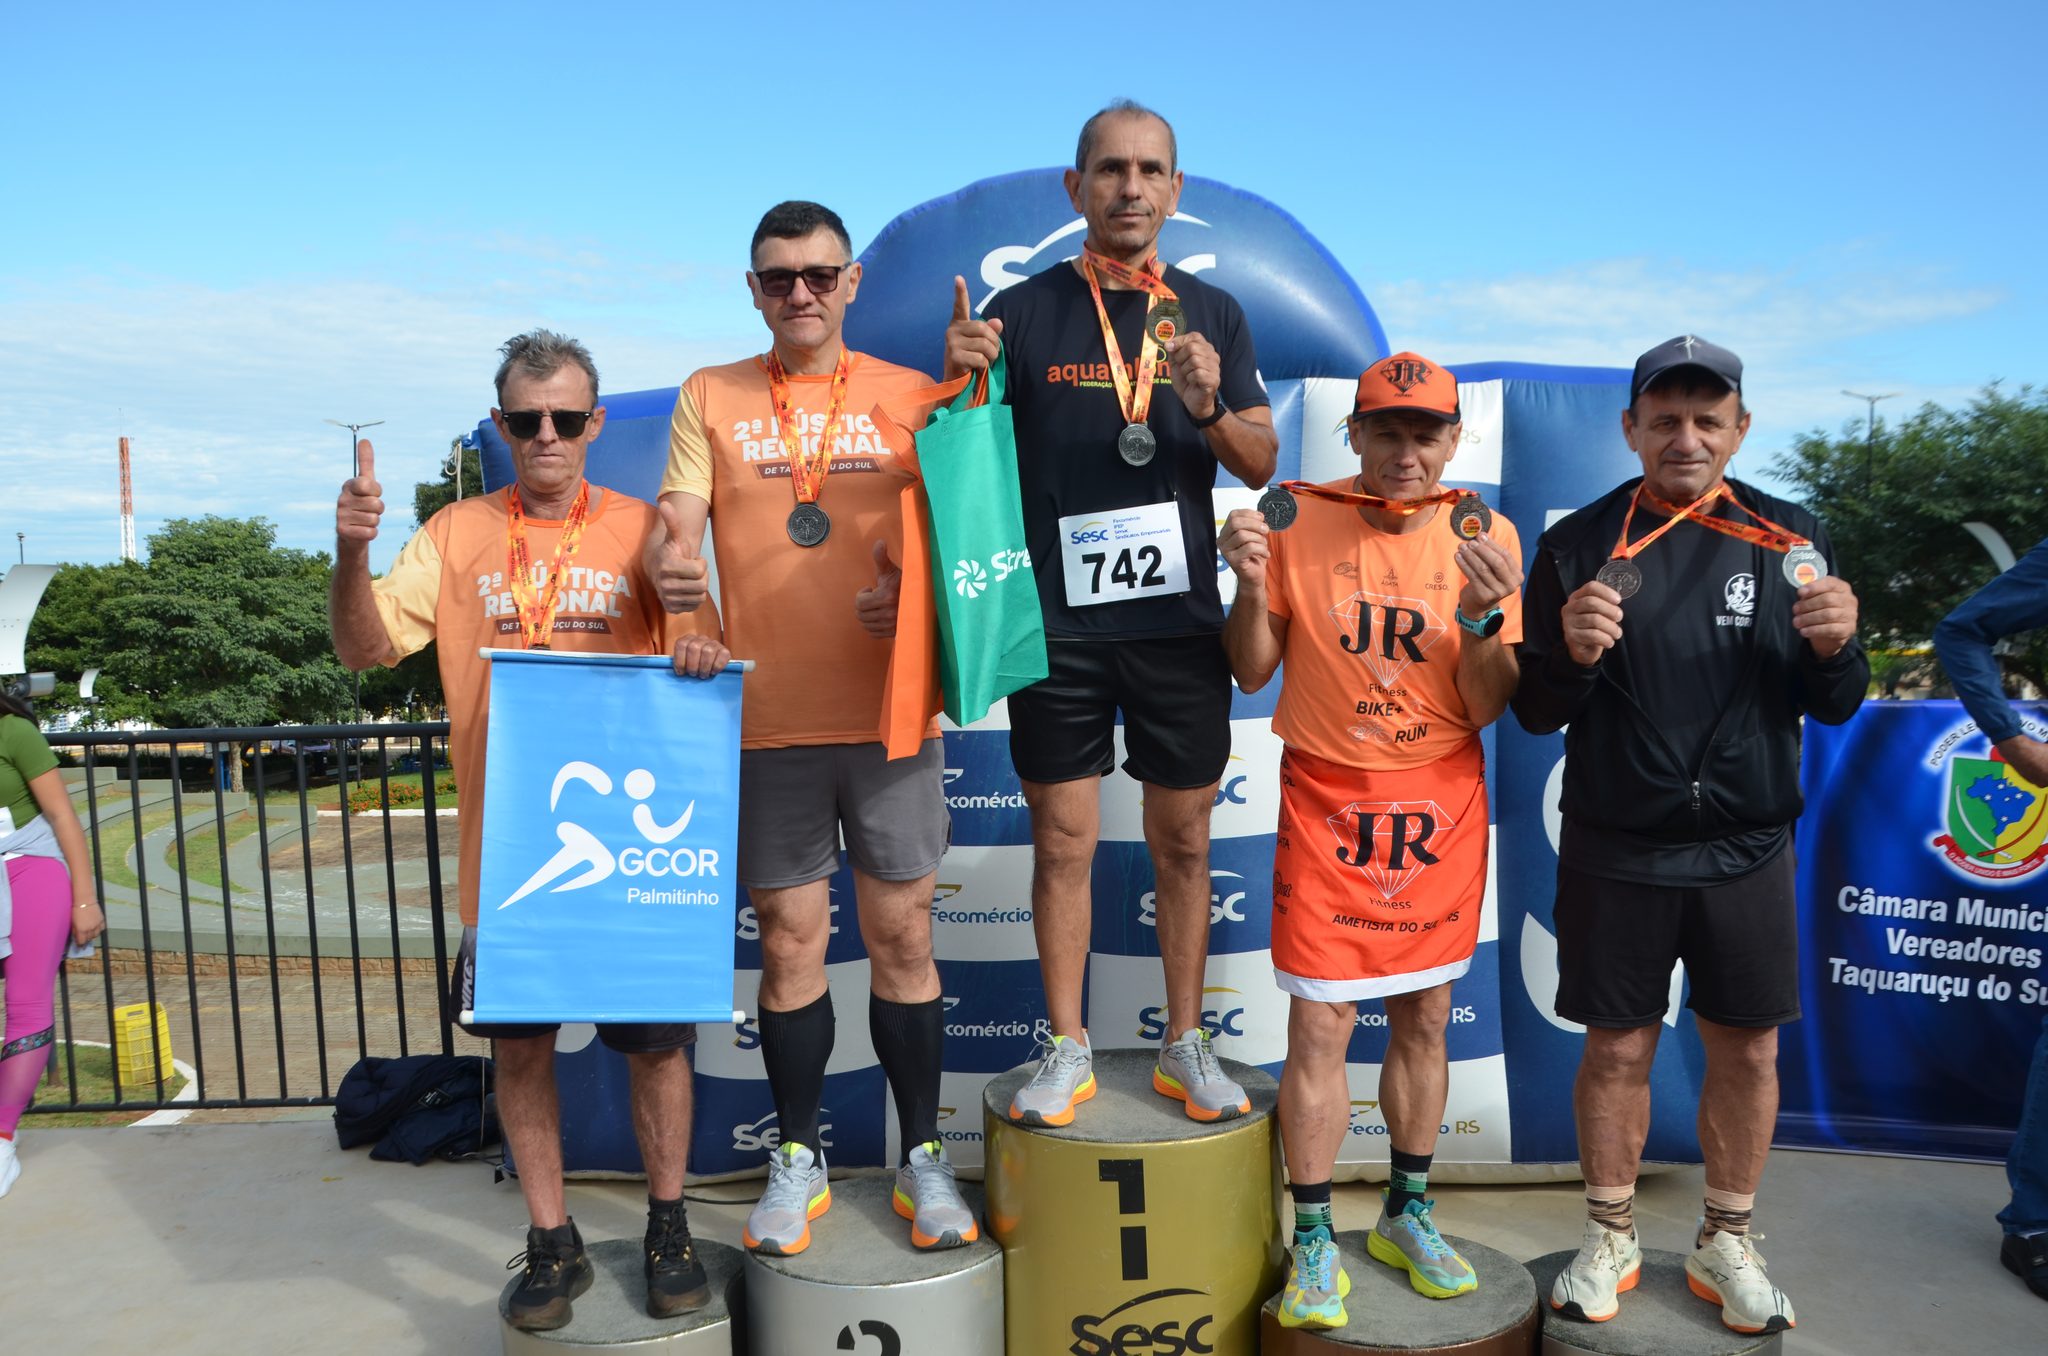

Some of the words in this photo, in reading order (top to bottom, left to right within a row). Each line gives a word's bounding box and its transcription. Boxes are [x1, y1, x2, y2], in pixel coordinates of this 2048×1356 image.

[733, 419, 763, 442] 2ª
[764, 466, 777, 475] DE
[854, 461, 872, 469] SUL
[1082, 545, 1166, 594] 742
[477, 572, 502, 597] 2ª
[485, 590, 622, 618] REONAL
[502, 623, 515, 631] DE
[588, 621, 604, 630] SUL
[1340, 600, 1429, 663] JR
[1369, 683, 1408, 697] Fitness
[1395, 723, 1428, 744] RUN
[1337, 811, 1440, 870] JR
[618, 847, 719, 877] GCOR
[627, 888, 719, 906] Palmitinho
[1138, 887, 1246, 926] Ssc
[1838, 885, 1948, 923] Câmara
[1332, 913, 1394, 932] AMETISTA
[1399, 922, 1418, 933] DO
[1886, 927, 2042, 969] Vereadores
[1828, 957, 1970, 1003] Taquaruçu
[1977, 974, 2011, 1001] do
[1137, 1002, 1244, 1040] Ssc
[1452, 1006, 1476, 1024] RS
[1455, 1119, 1481, 1134] RS
[1098, 1159, 1149, 1280] 1
